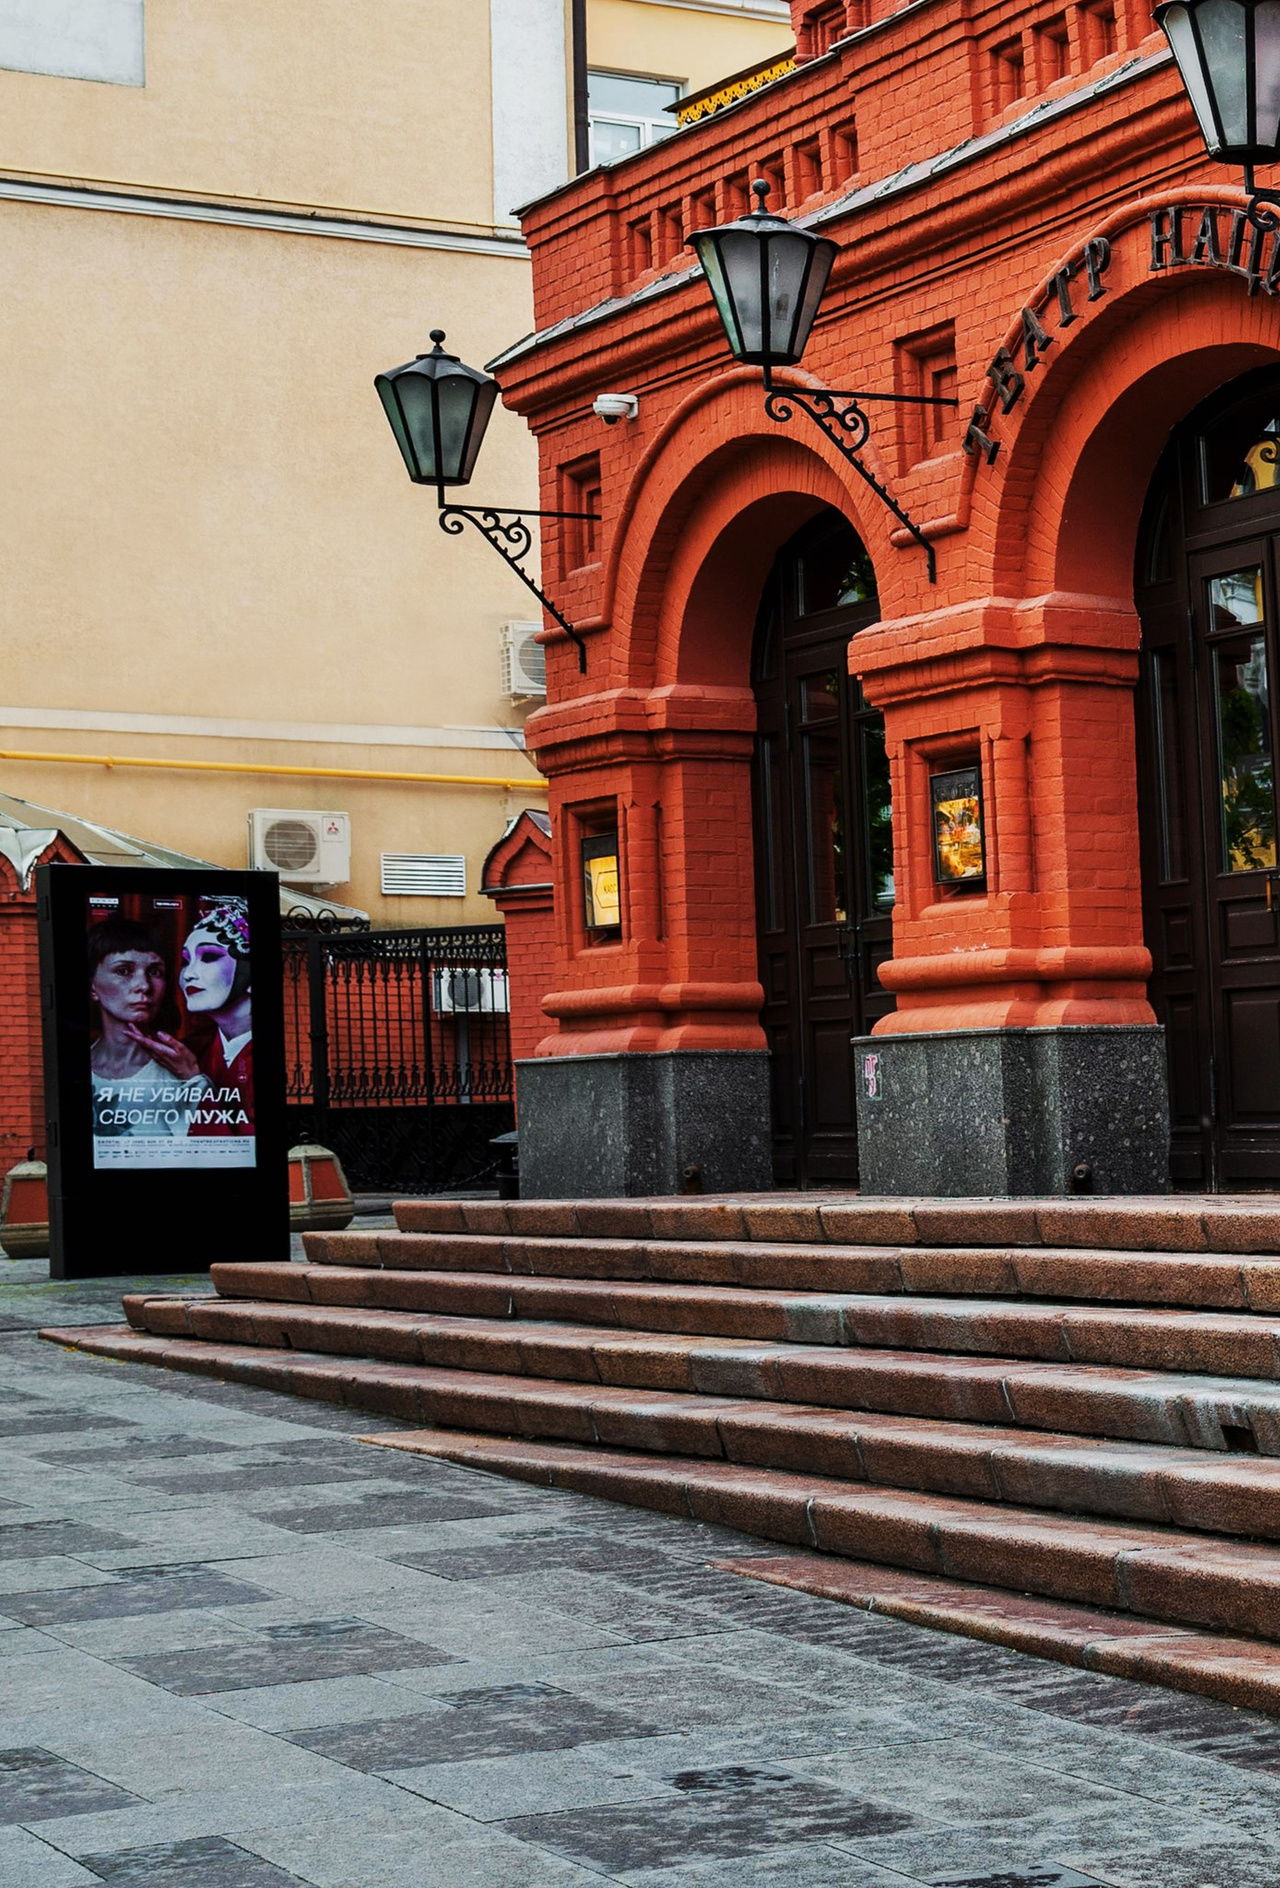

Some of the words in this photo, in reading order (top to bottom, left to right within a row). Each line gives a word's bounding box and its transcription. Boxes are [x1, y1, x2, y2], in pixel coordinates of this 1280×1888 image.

[962, 236, 1111, 466] ТЕАТР
[97, 1087, 113, 1102] Я
[118, 1087, 146, 1102] НЕ
[149, 1087, 242, 1102] УБИВАЛА
[99, 1109, 179, 1125] СВОЕГО
[184, 1109, 250, 1124] МУЖА
